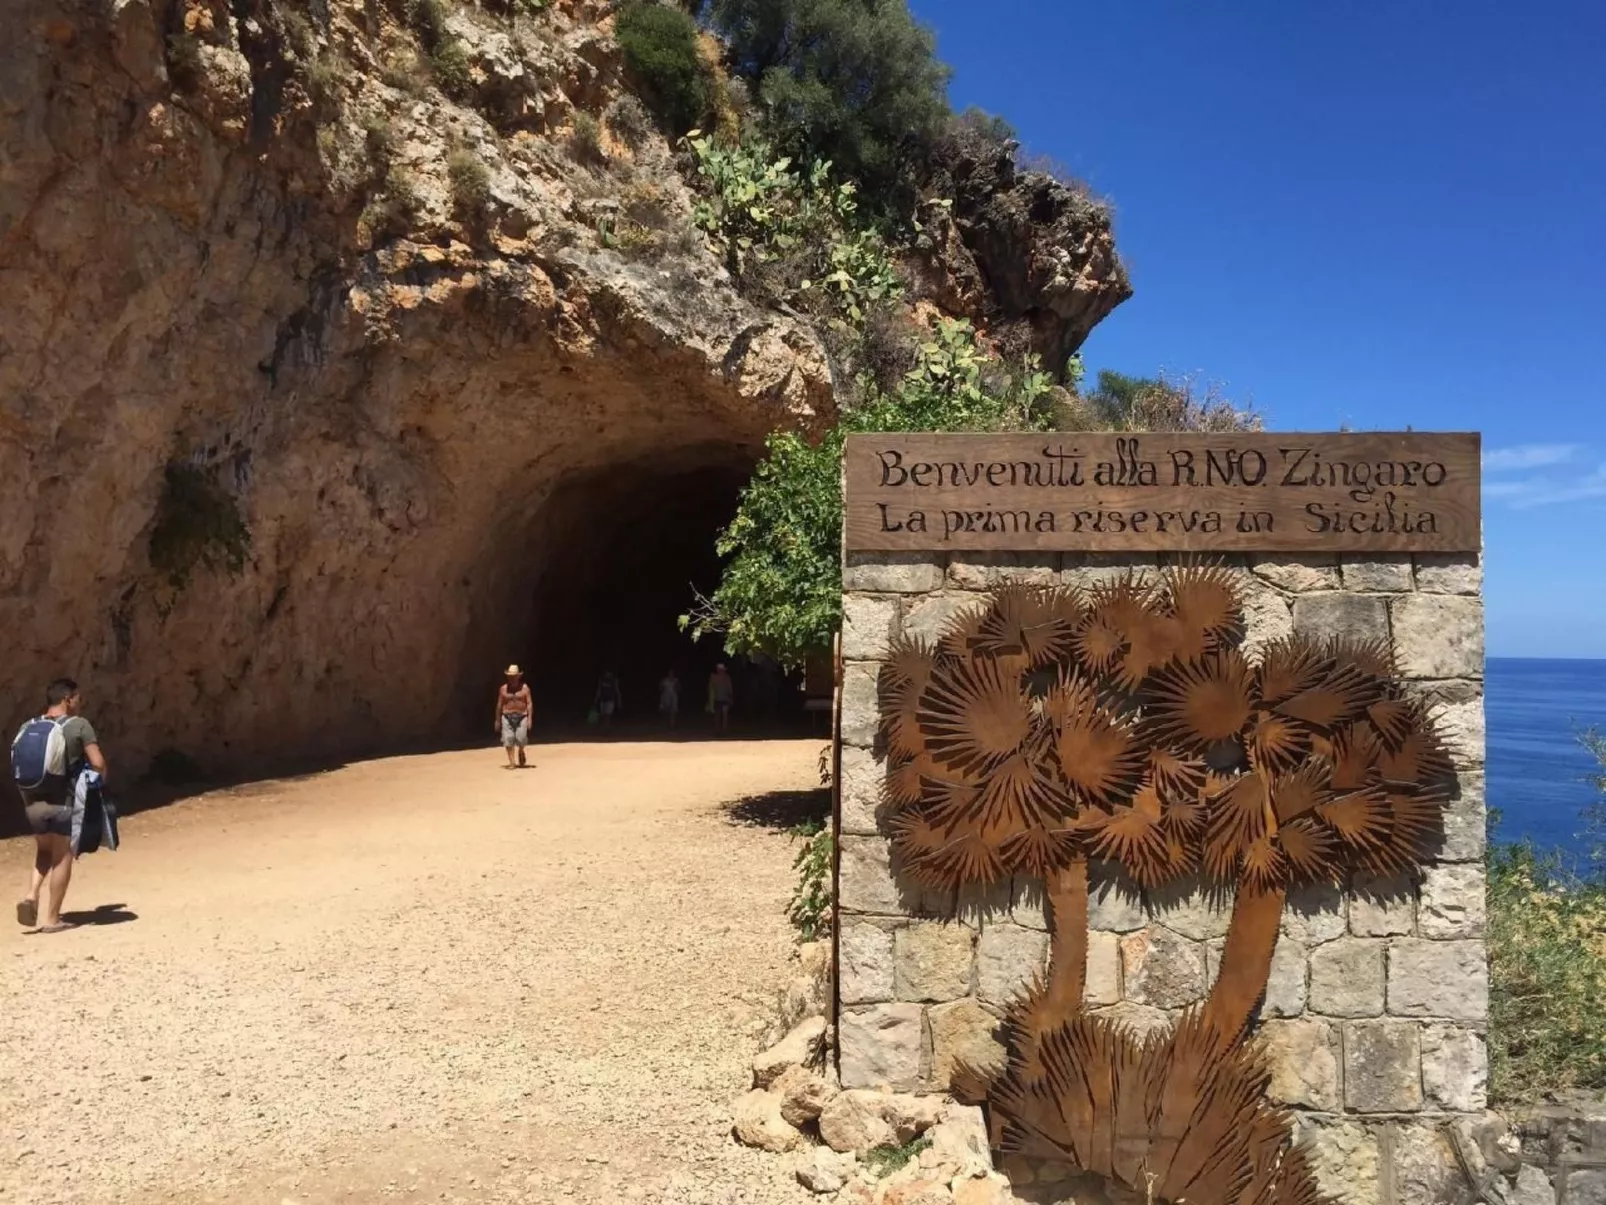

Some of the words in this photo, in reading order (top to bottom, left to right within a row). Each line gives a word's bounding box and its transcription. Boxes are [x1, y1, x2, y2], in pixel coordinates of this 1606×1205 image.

[876, 444, 1088, 487] Benvenuti
[1093, 437, 1158, 487] alla
[1279, 448, 1446, 503] Zingaro
[875, 502, 927, 533] La
[941, 503, 1056, 541] prima
[1071, 502, 1222, 533] riserva
[1235, 502, 1274, 533] in
[1305, 491, 1440, 534] Sicilia
